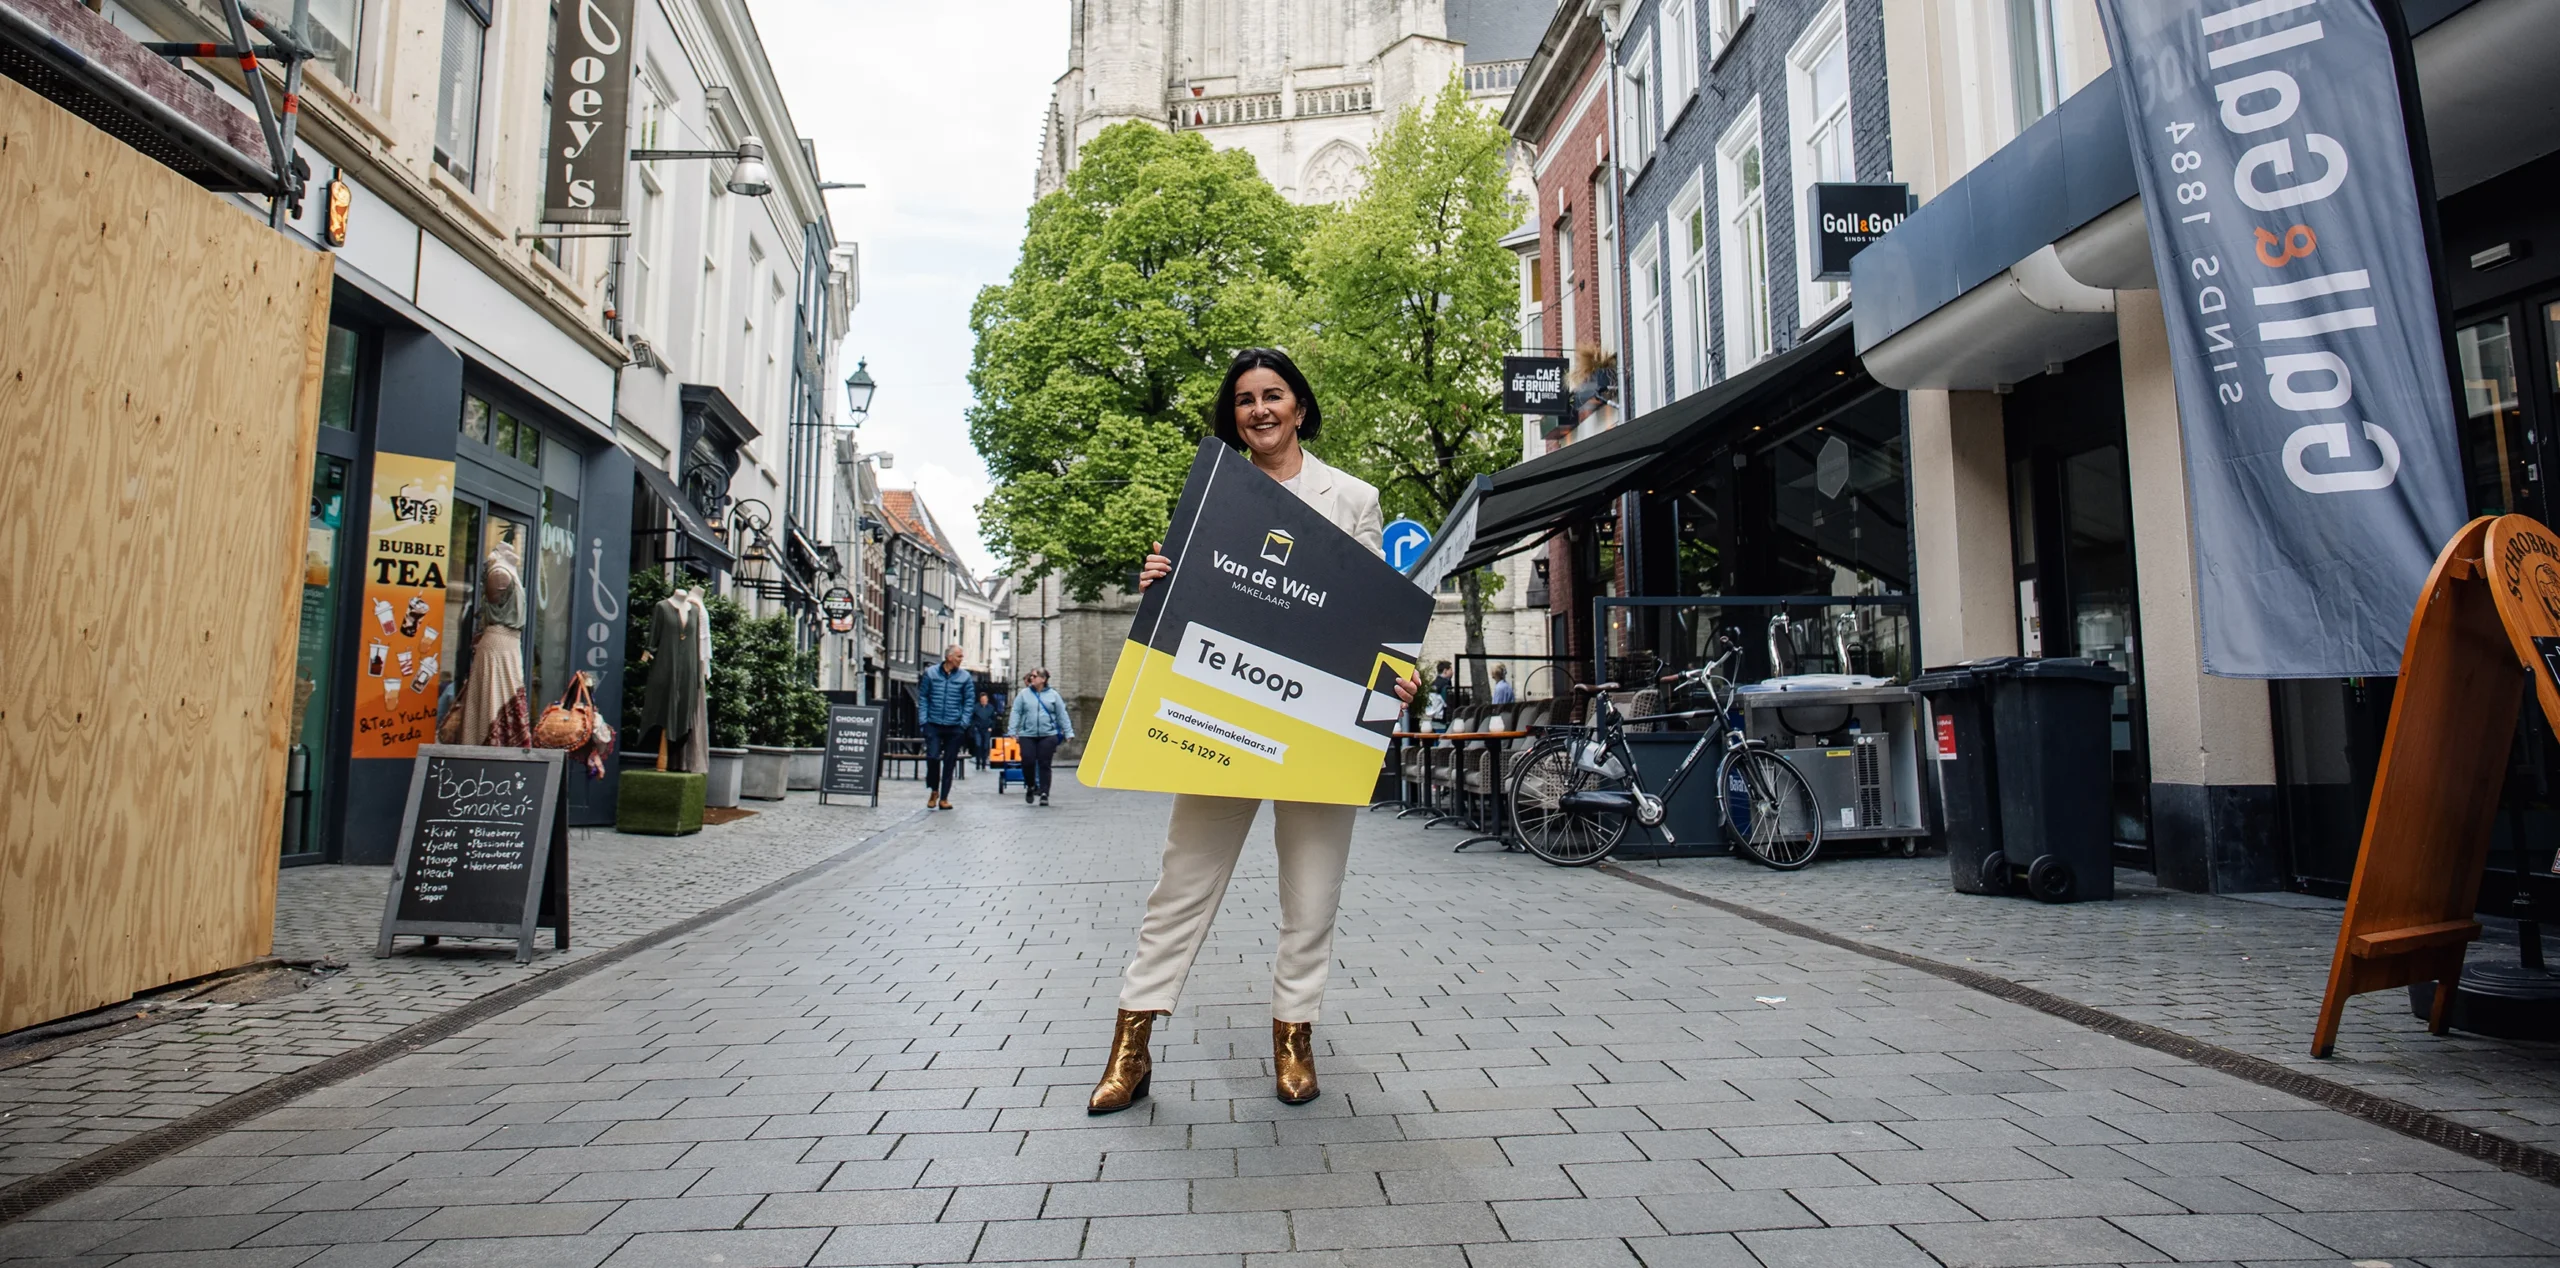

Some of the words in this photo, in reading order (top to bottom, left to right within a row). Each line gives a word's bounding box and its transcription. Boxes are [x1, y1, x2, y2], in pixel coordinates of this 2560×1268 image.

[1536, 366, 1560, 381] CAFÉ
[1512, 379, 1525, 391] DE
[1525, 380, 1560, 393] BRUINE
[1525, 391, 1541, 403] PIJ
[379, 539, 446, 558] BUBBLE
[373, 557, 447, 589] TEA
[1213, 549, 1249, 579] Van
[1251, 568, 1277, 589] de
[1282, 576, 1328, 608] Wiel
[1231, 581, 1292, 610] MAKELAARS
[824, 600, 853, 610] PIZZA
[1198, 638, 1226, 670] Te
[1231, 652, 1303, 702] koop
[360, 716, 394, 733] &Tea
[835, 715, 875, 724] CHOCOLAT
[381, 726, 422, 747] Breda
[838, 730, 868, 738] LUNCH
[1167, 708, 1278, 756] vandewielmakelaars.nl
[835, 737, 870, 746] BORREL
[838, 745, 865, 753] DINER
[1147, 727, 1170, 744] 076
[1180, 739, 1196, 754] 54
[1197, 746, 1217, 760] 129
[1217, 754, 1232, 768] 76
[438, 768, 512, 799] Boba
[448, 798, 526, 818] Smaken
[430, 825, 458, 838] Kiwi
[474, 827, 521, 839] Blueberry
[426, 856, 458, 867] Mango
[423, 869, 454, 879] Peach
